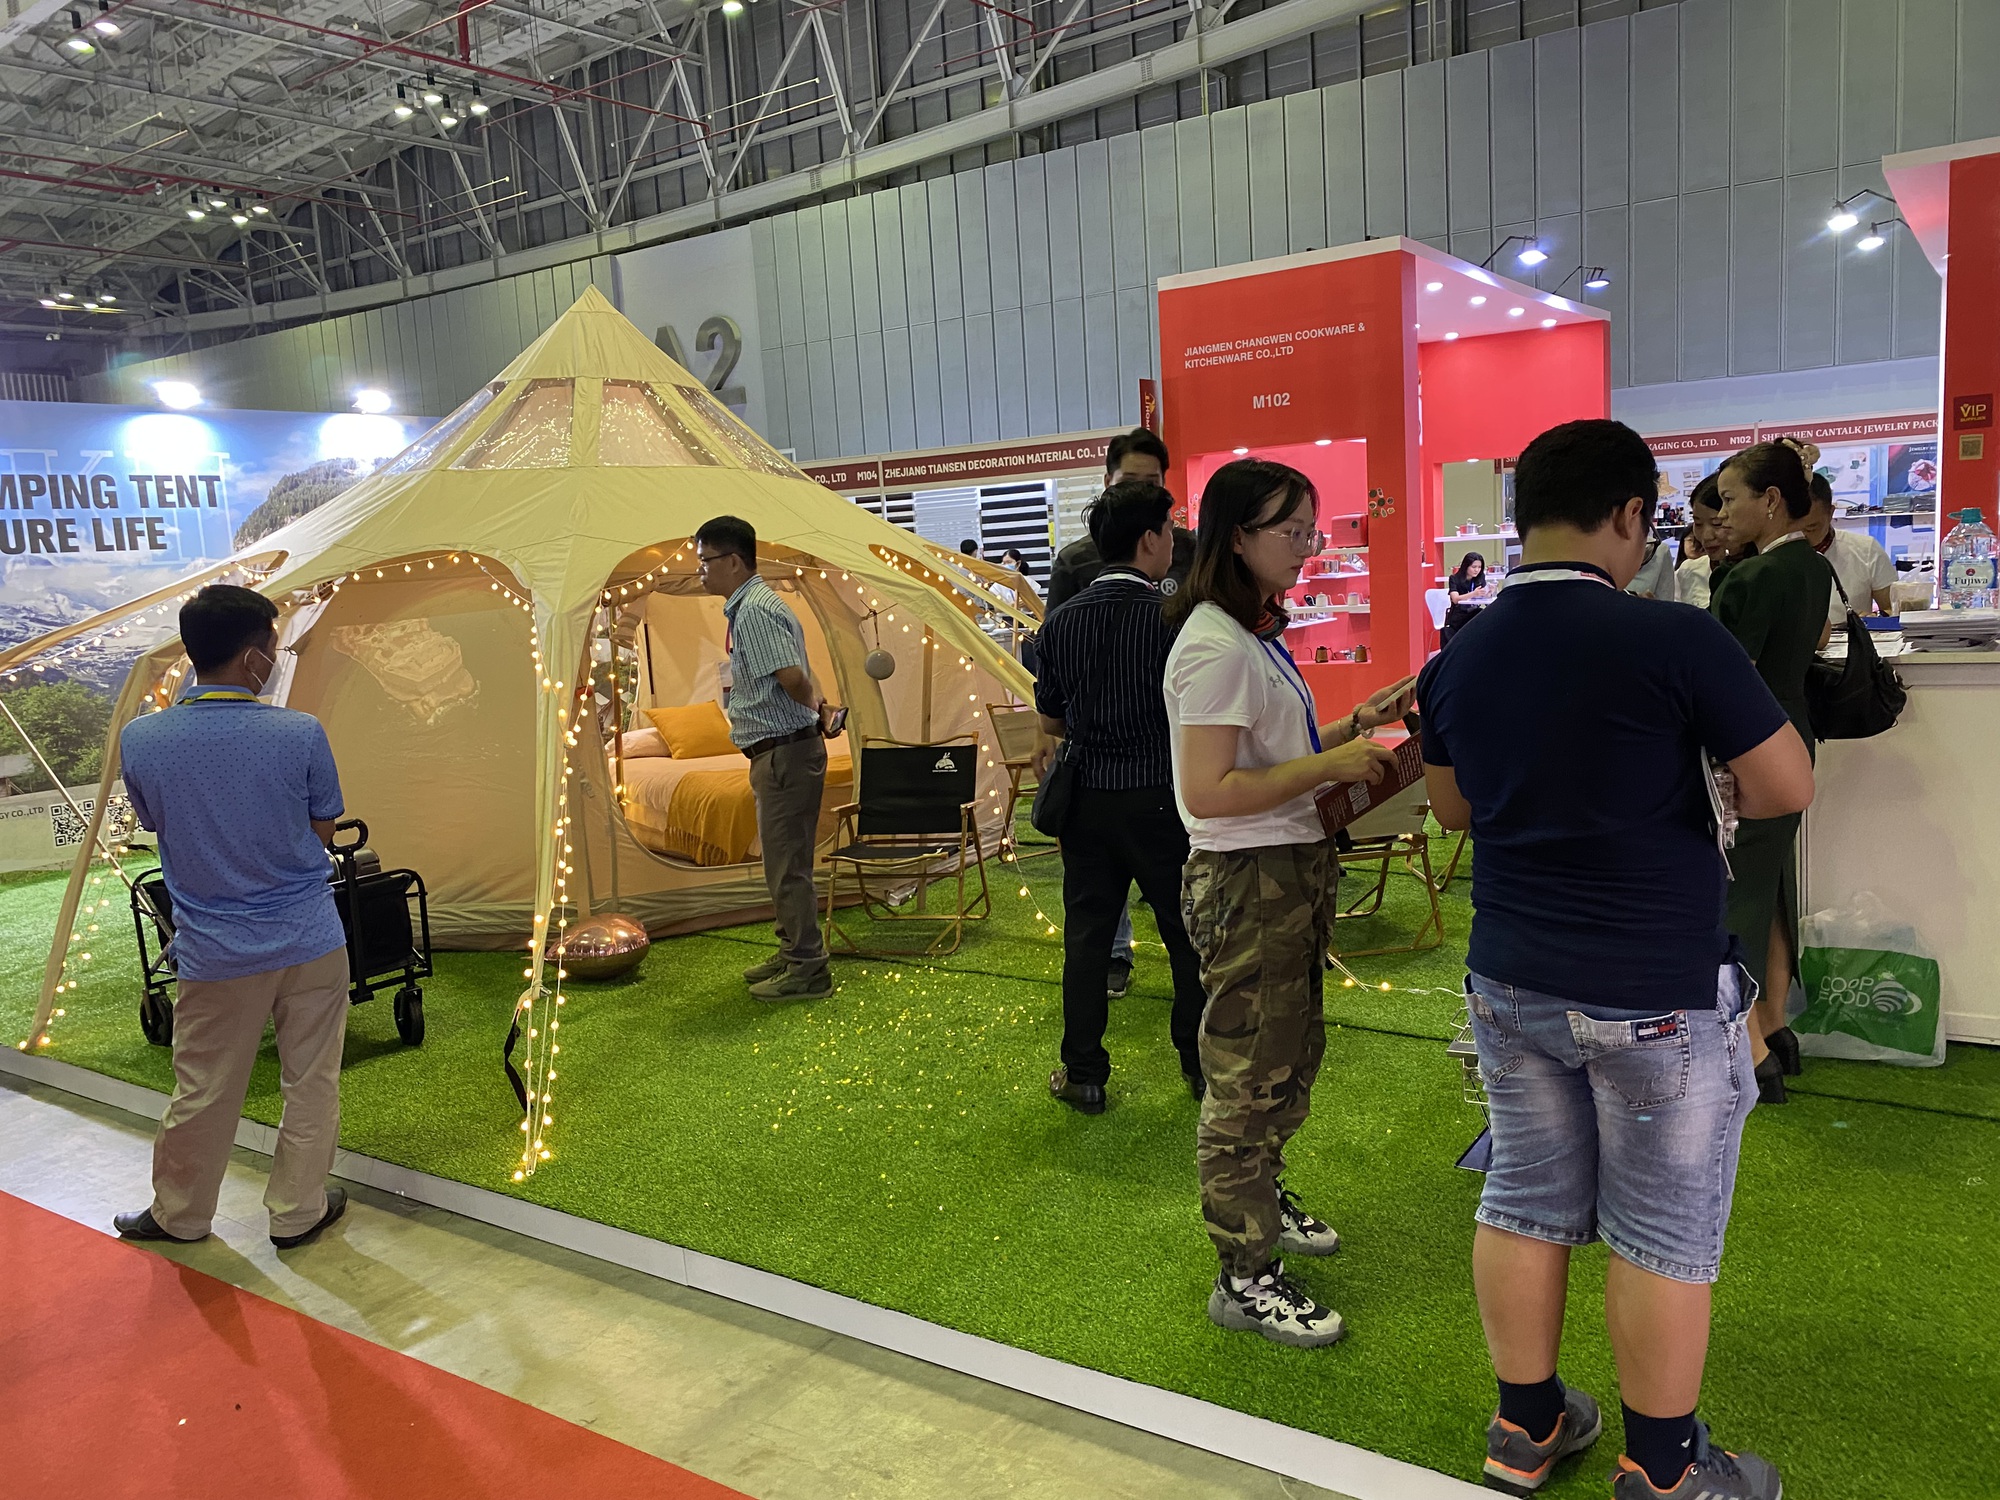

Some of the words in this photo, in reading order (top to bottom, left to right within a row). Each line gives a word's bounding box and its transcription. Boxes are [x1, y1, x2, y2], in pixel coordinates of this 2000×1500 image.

[1184, 341, 1233, 357] JIANGMEN
[1235, 332, 1293, 349] CHANGWEN
[1295, 323, 1356, 340] COOKWARE
[1358, 322, 1366, 332] &
[1184, 351, 1254, 369] KITCHENWARE
[1255, 345, 1294, 359] CO.,LTD
[1253, 392, 1291, 410] M102
[1960, 403, 1987, 418] VIP
[1815, 425, 1863, 437] CANTALK
[1863, 421, 1911, 435] JEWELRY
[1700, 438, 1719, 447] LTD.
[1730, 435, 1752, 445] N102
[884, 465, 927, 479] ZHEJIANG
[927, 461, 967, 475] TIANSEN
[967, 455, 1025, 471] DECORATION
[1026, 449, 1076, 465] MATERIAL
[1076, 447, 1096, 459] CO.,
[1097, 445, 1110, 457] LT
[831, 472, 847, 483] LTD
[857, 470, 878, 481] M104
[129, 474, 221, 509] TENT
[91, 516, 168, 552] LIFE
[1954, 577, 1989, 586] Fujiwa
[11, 806, 44, 818] CO.,LTD
